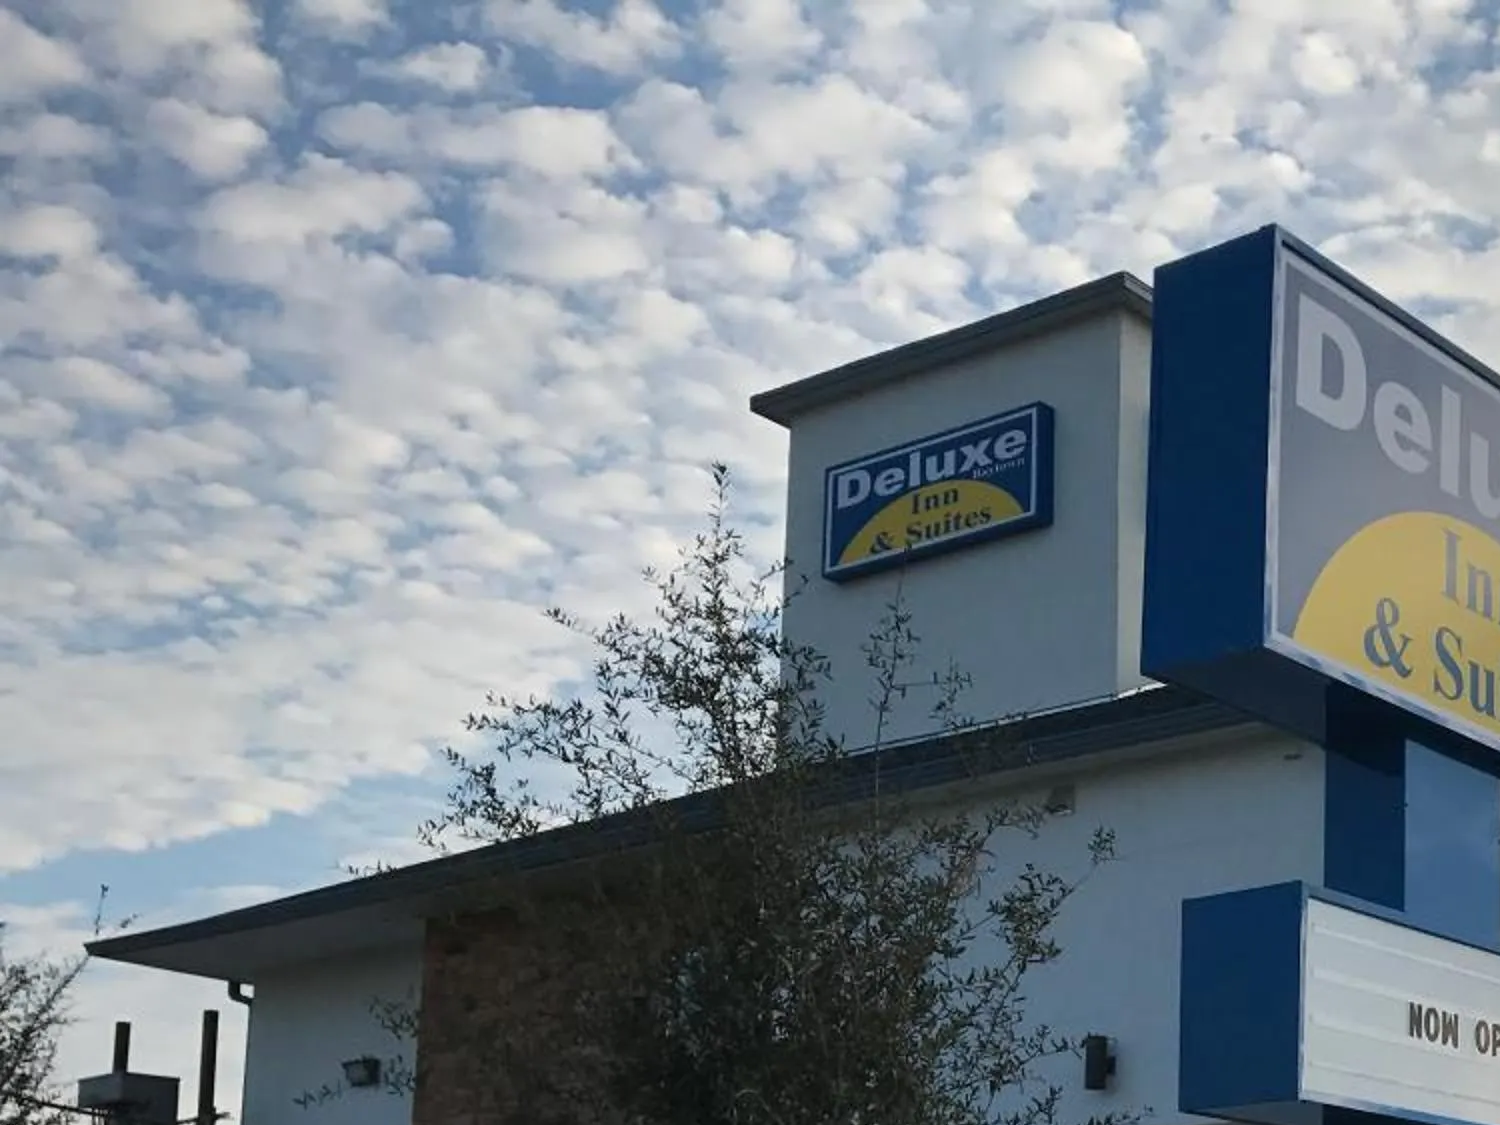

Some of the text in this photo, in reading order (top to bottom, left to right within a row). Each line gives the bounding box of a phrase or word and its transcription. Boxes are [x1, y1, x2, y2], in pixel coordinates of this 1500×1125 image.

[836, 428, 1028, 510] Deluxe
[911, 487, 959, 514] Inn
[869, 506, 993, 554] & Suites
[1363, 597, 1414, 680] &
[1408, 1000, 1460, 1050] NOW
